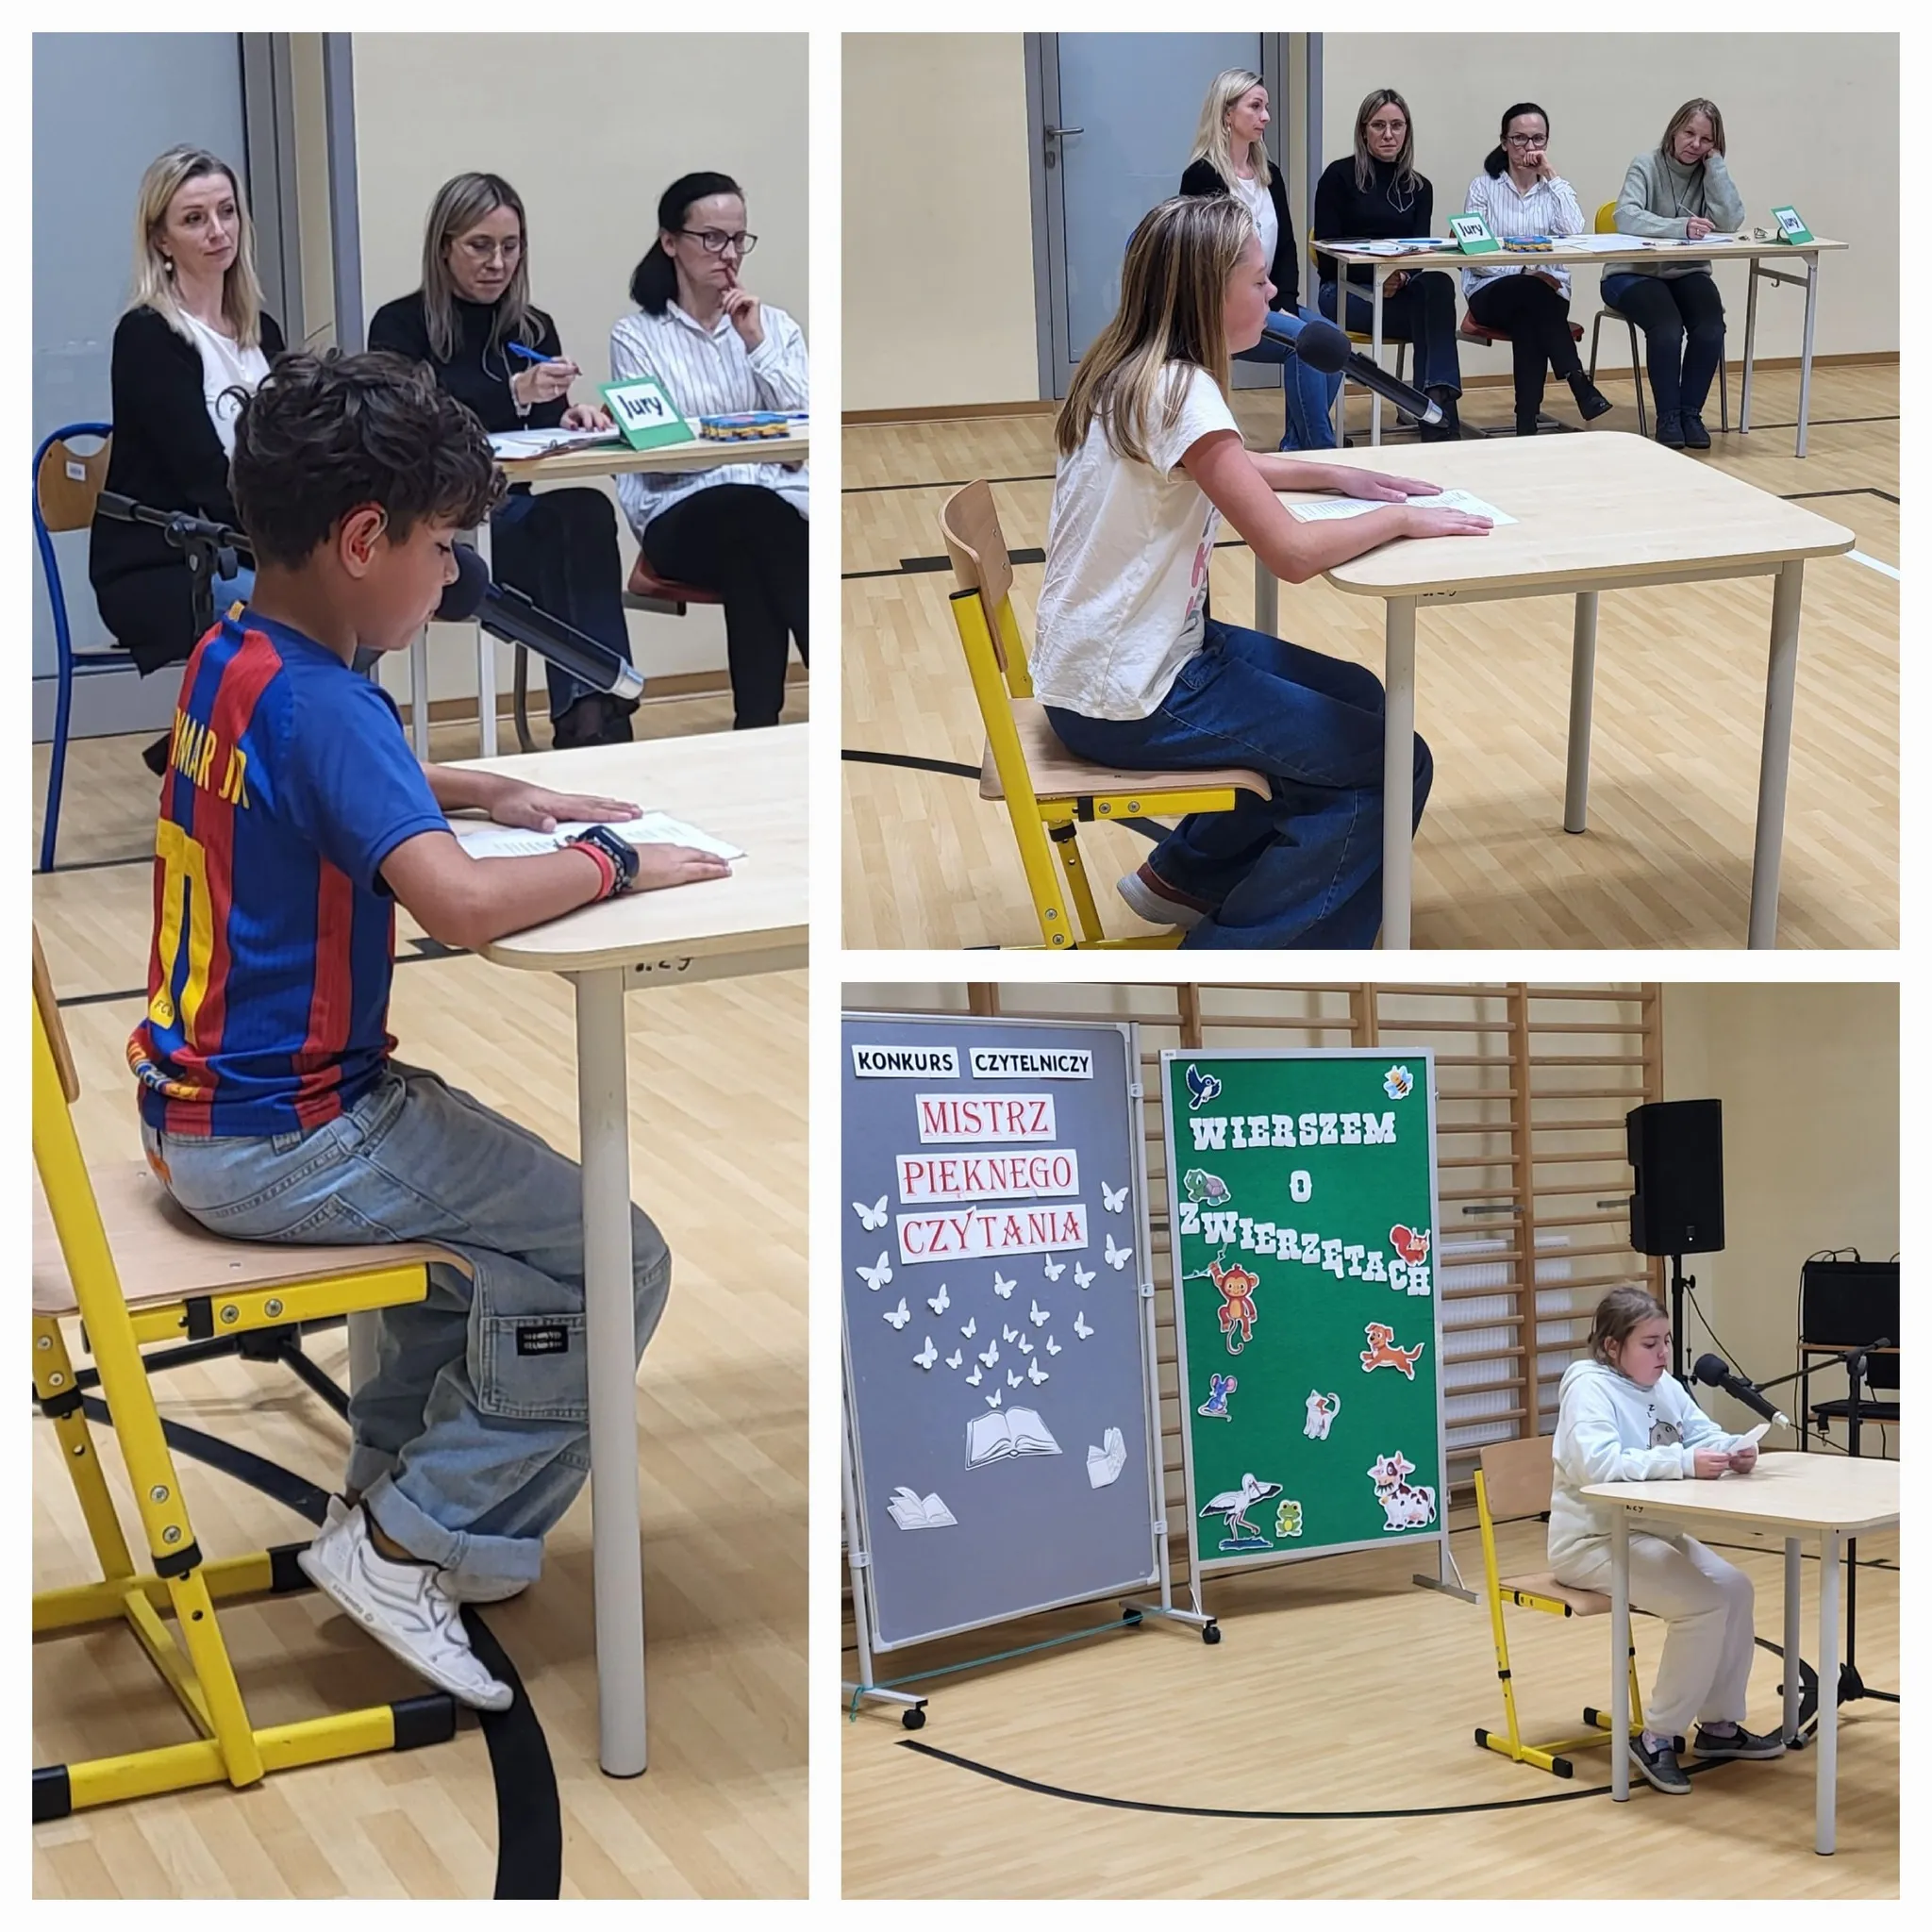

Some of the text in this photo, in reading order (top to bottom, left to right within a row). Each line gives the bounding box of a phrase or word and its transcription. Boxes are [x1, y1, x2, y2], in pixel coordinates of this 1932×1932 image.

[1457, 223, 1484, 237] Jury
[617, 394, 663, 419] Jury
[218, 743, 250, 809] JR
[858, 1052, 1089, 1073] KONKURS CZYTELNICZY
[922, 1101, 1049, 1135] MISTRZ
[1190, 1112, 1396, 1150] WIERSZEM
[903, 1157, 1071, 1198] PIĘKNEGO
[1290, 1170, 1312, 1203] O
[903, 1210, 1081, 1255] CZYTANIA
[1179, 1202, 1431, 1296] ZWIERZĘTACH
